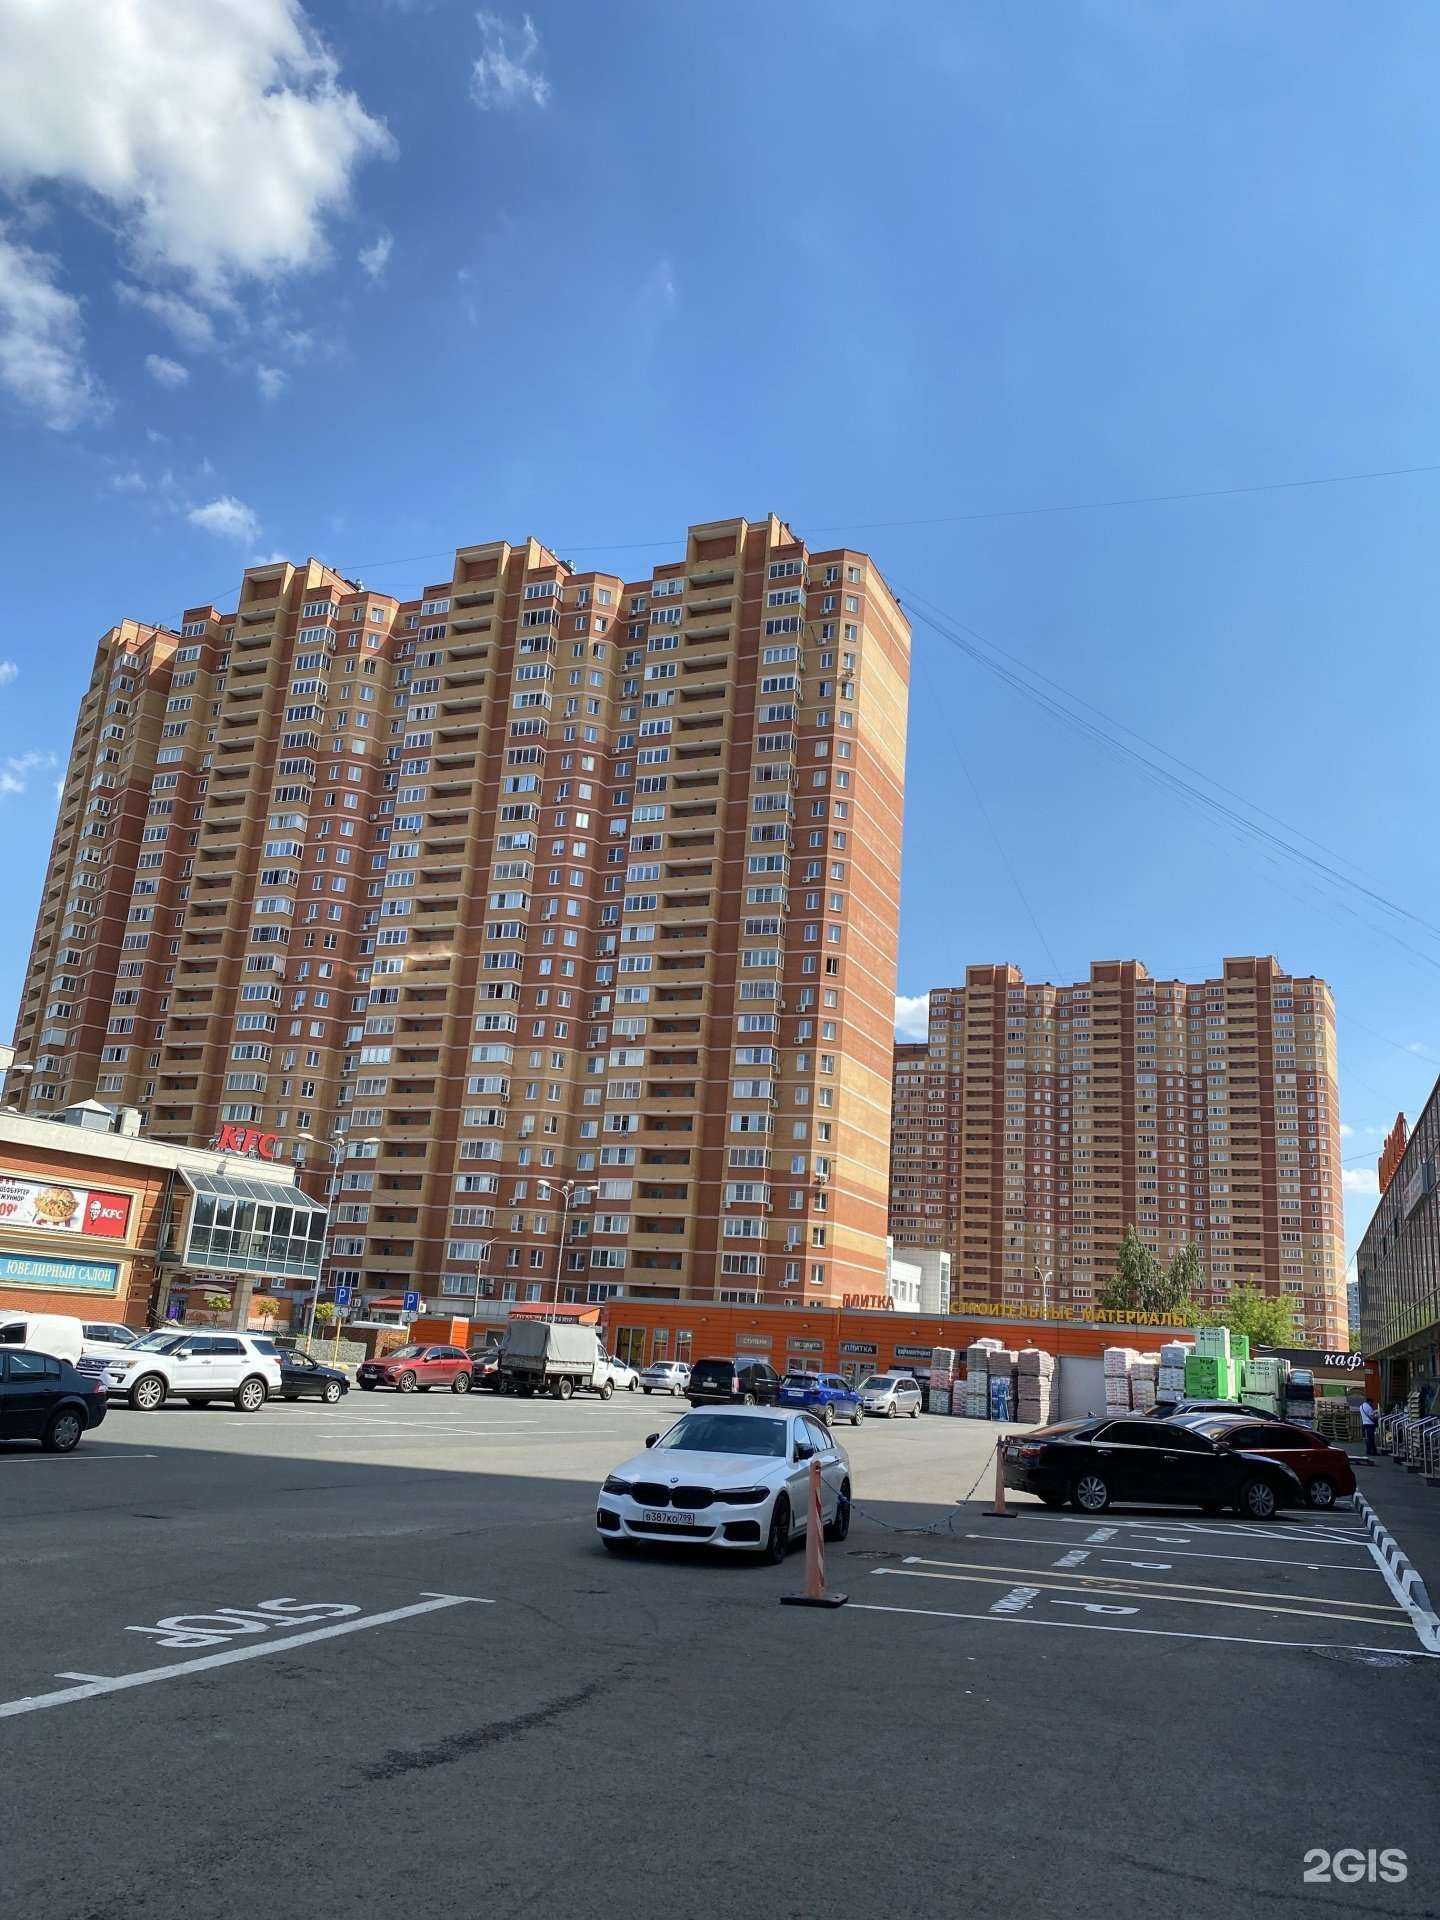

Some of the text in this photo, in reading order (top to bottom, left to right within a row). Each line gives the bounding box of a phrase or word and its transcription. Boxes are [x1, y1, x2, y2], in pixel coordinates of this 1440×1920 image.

[218, 1124, 279, 1161] KFC
[101, 1207, 124, 1220] KFC
[6, 1260, 112, 1282] ЮВЕЛИРНЫЙ САЛОН
[842, 1294, 895, 1311] ПЛИТКА
[950, 1302, 1188, 1327] СТРОИТЕЛЬНЫЕ МАТЕРИАЛЫ
[844, 1343, 874, 1353] ПЛИТКА
[1324, 1351, 1365, 1371] каф
[124, 1597, 362, 1648] STOP
